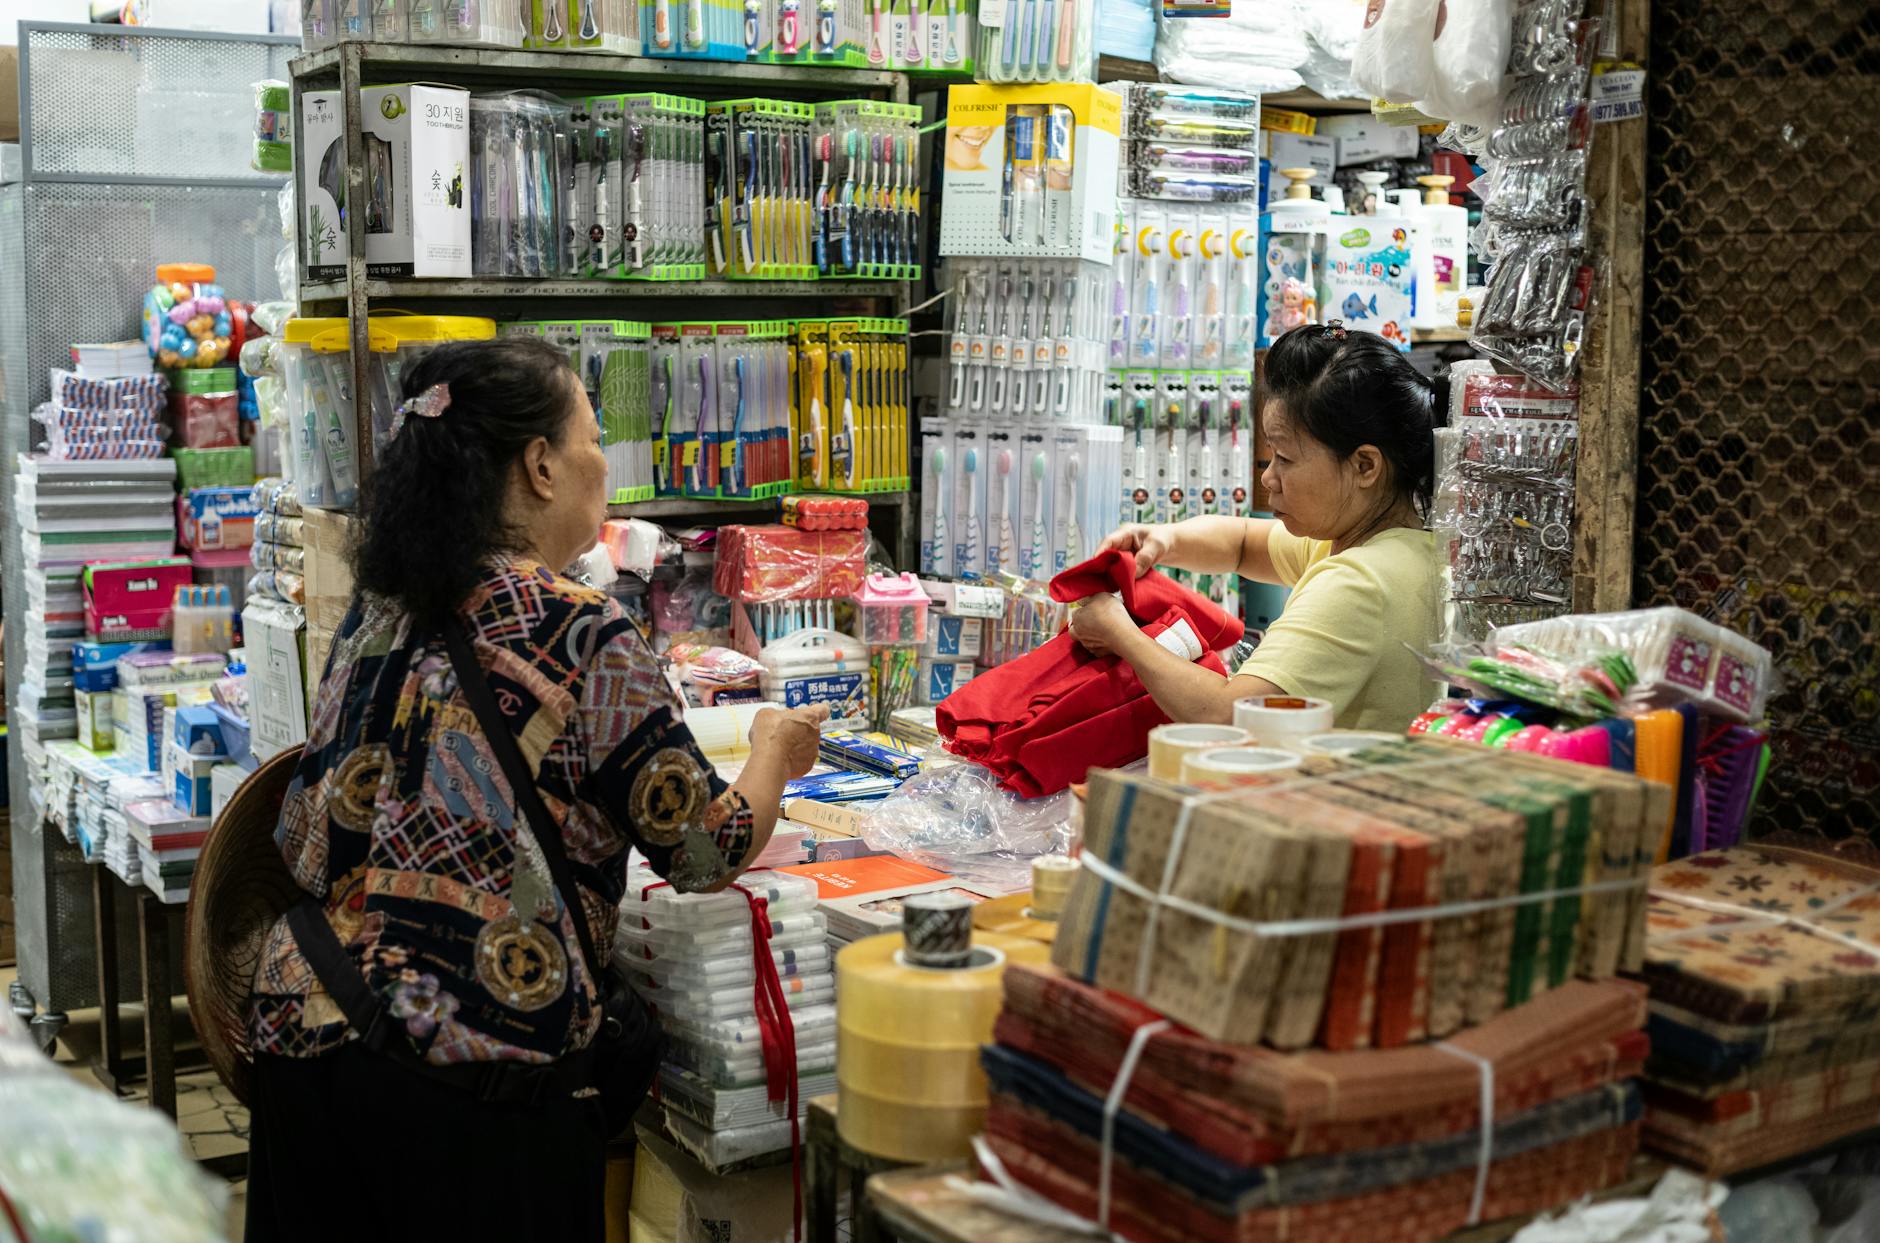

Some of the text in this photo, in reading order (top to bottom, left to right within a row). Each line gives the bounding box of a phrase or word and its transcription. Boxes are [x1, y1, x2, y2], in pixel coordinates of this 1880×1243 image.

[425, 103, 464, 122] 30 지원
[953, 104, 998, 112] COLFRESH
[426, 120, 464, 130] TOOTHBRUSH
